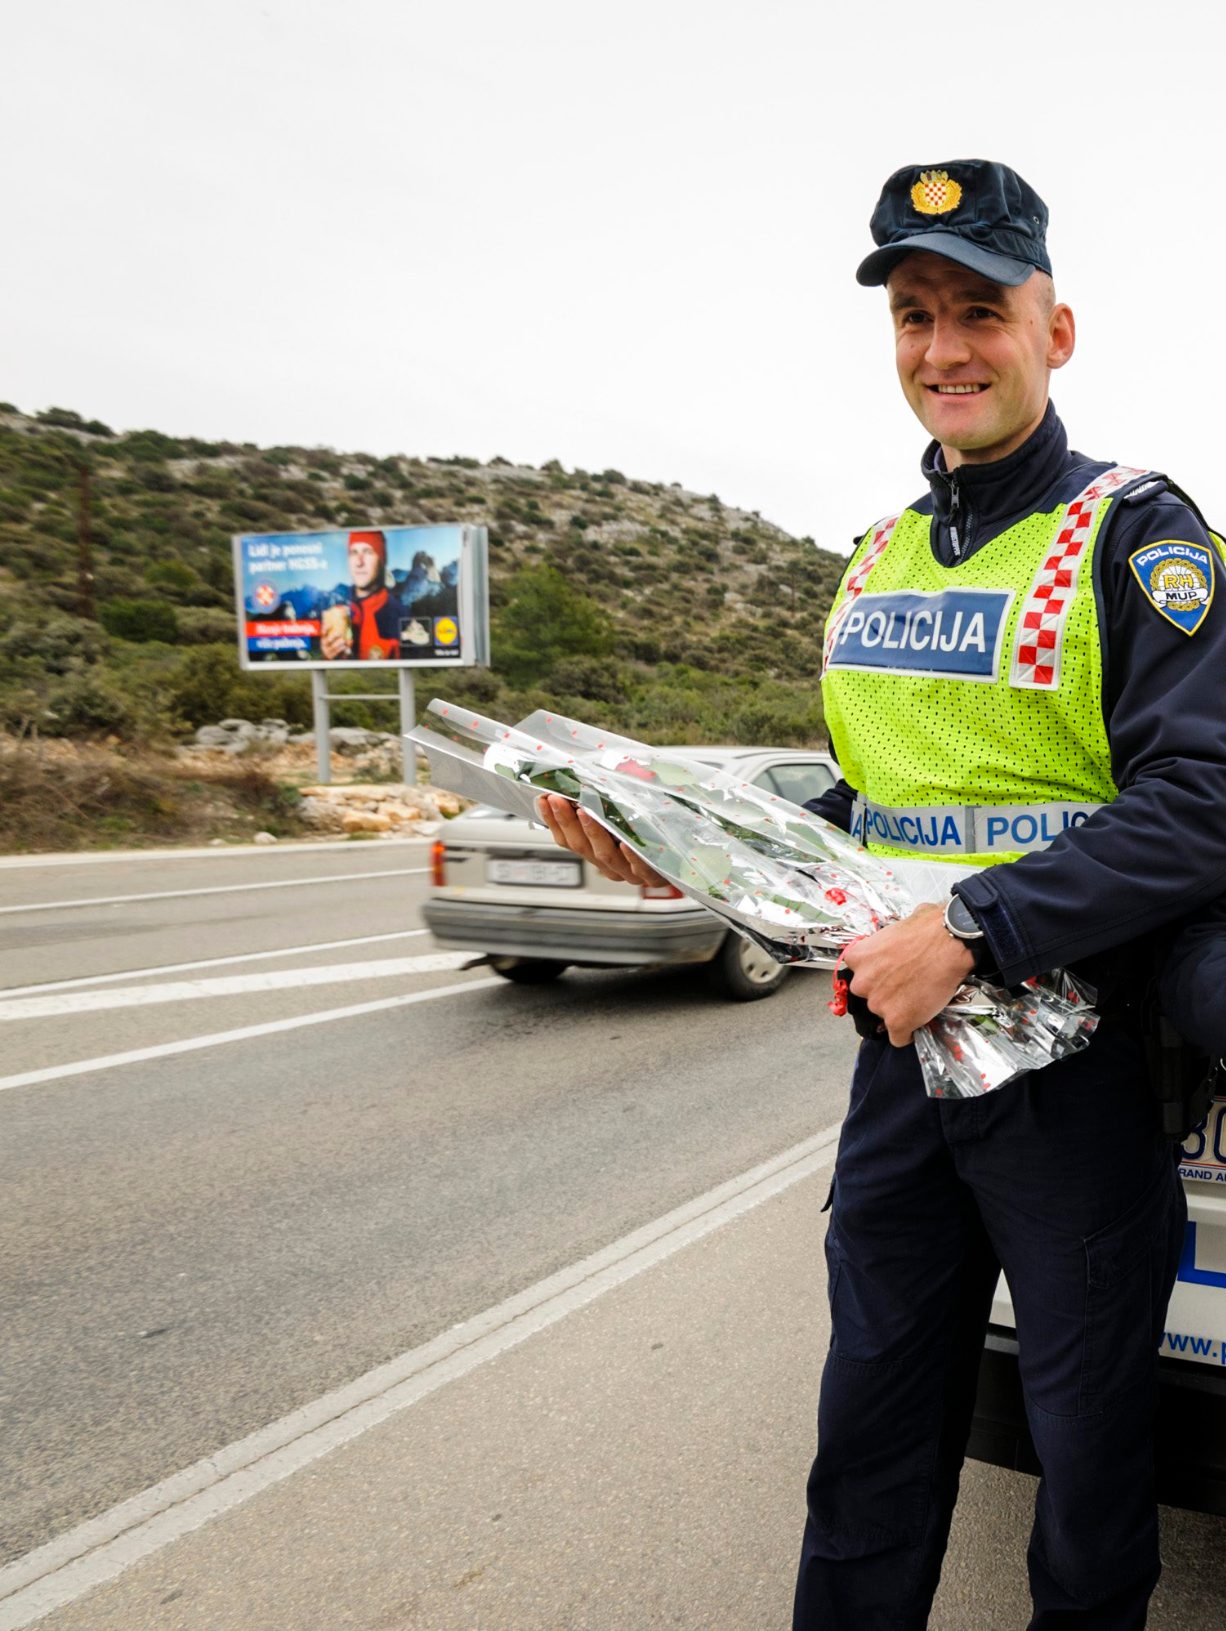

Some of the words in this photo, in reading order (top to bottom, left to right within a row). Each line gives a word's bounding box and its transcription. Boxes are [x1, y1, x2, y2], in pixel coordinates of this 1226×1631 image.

[1136, 546, 1208, 567] POLICIJA
[1164, 574, 1194, 589] RH
[1166, 591, 1198, 601] MUP
[840, 611, 986, 653] POLICIJA
[866, 807, 962, 847] POLICIJA
